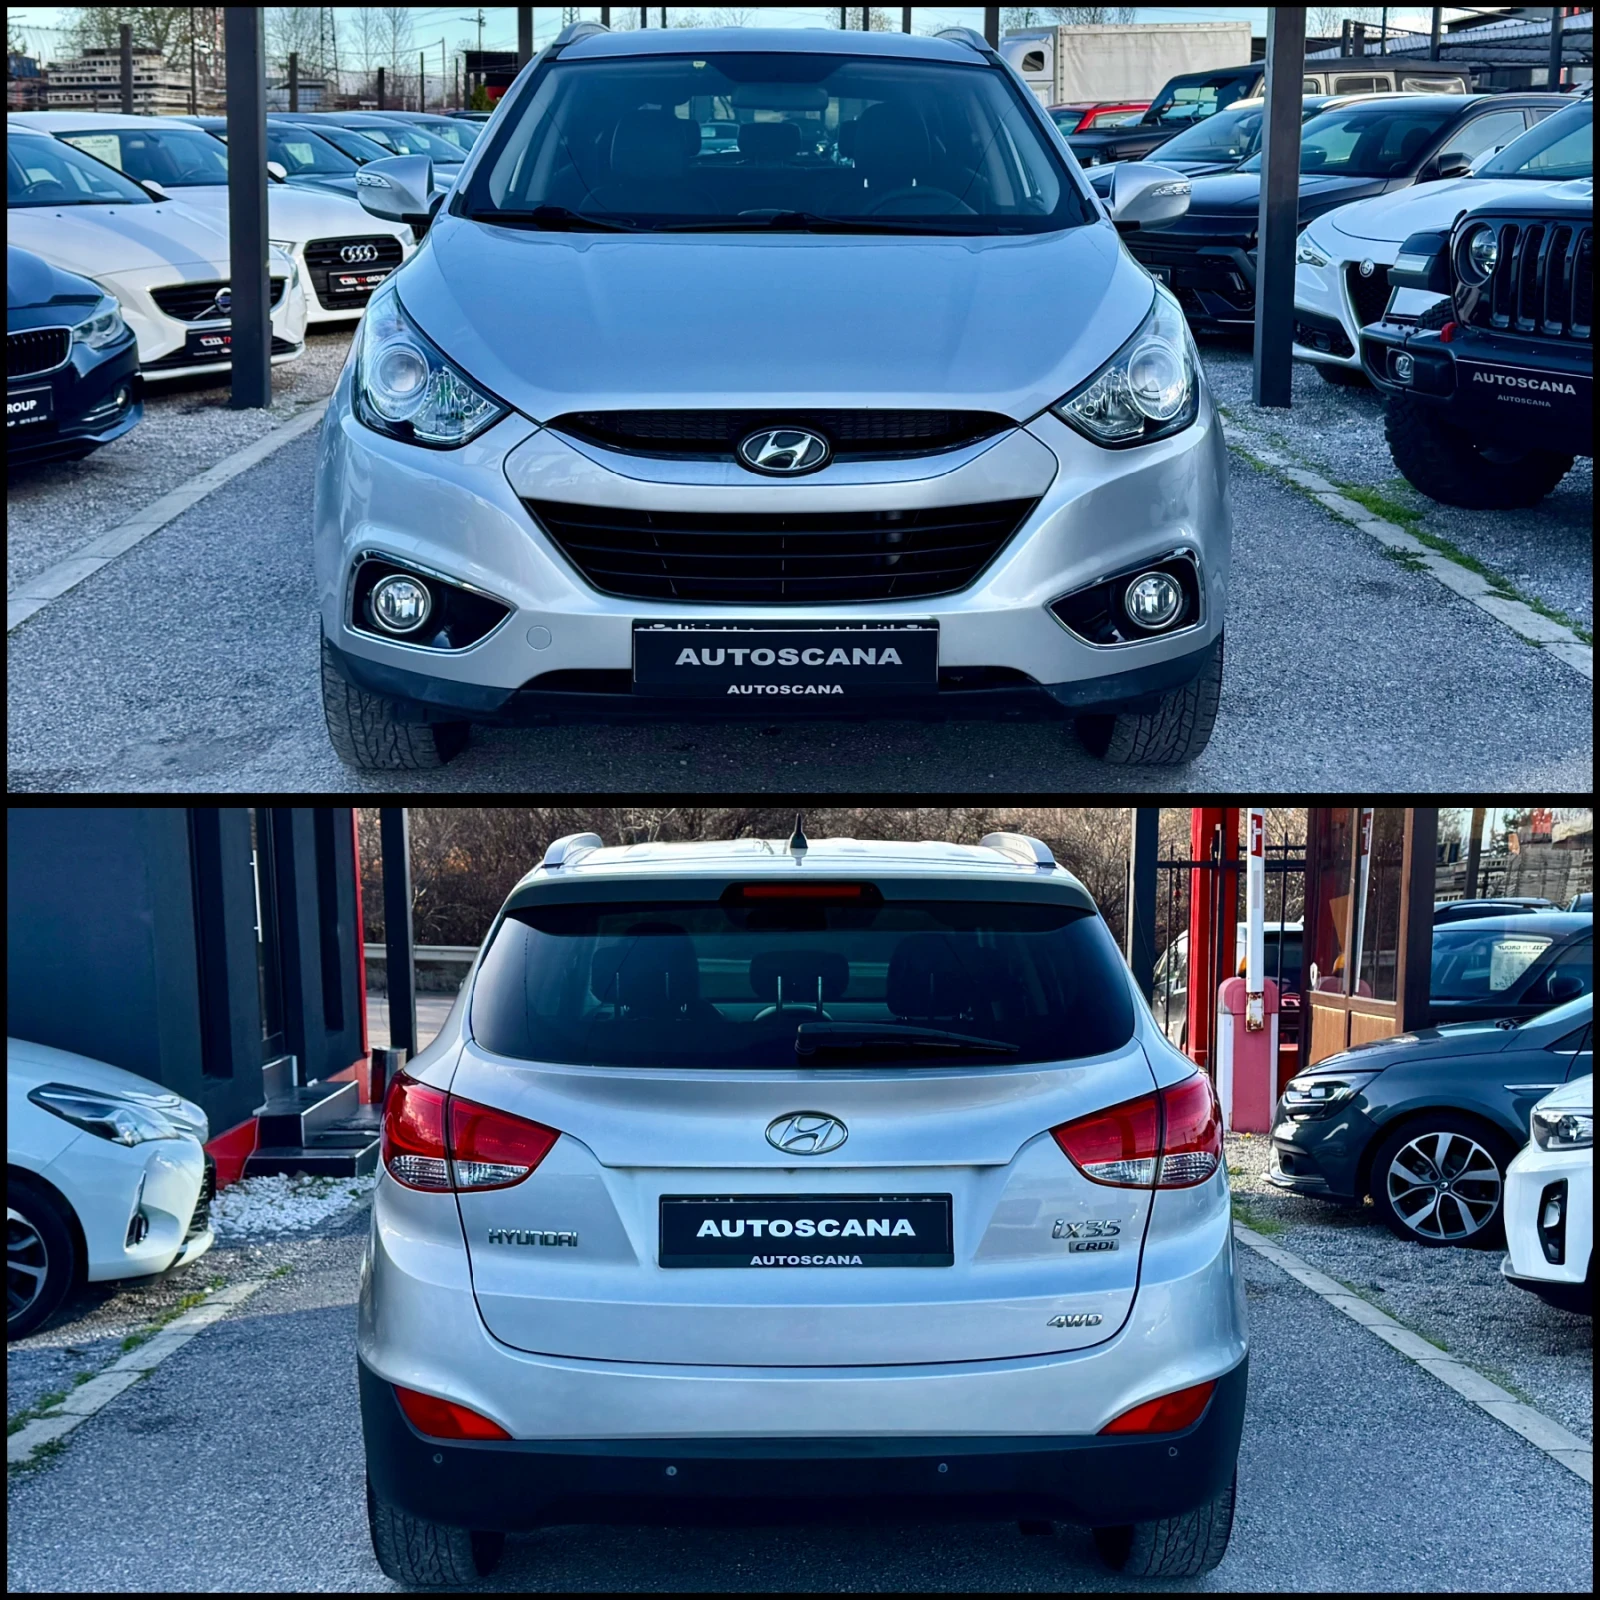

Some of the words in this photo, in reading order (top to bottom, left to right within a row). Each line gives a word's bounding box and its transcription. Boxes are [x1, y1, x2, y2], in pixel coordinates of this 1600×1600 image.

[1473, 371, 1576, 395] AUTOSCANA
[1497, 394, 1551, 408] AUTOSCANA
[675, 647, 903, 666] AUTOSCANA
[727, 684, 844, 695] AUTOSCANA
[696, 1218, 916, 1238] AUTOSCANA
[1051, 1218, 1122, 1240] ix35
[488, 1228, 578, 1247] HYUNDAI
[1075, 1240, 1115, 1252] CRDi
[750, 1254, 863, 1266] AUTOSCANA
[1046, 1312, 1103, 1328] 4WD
